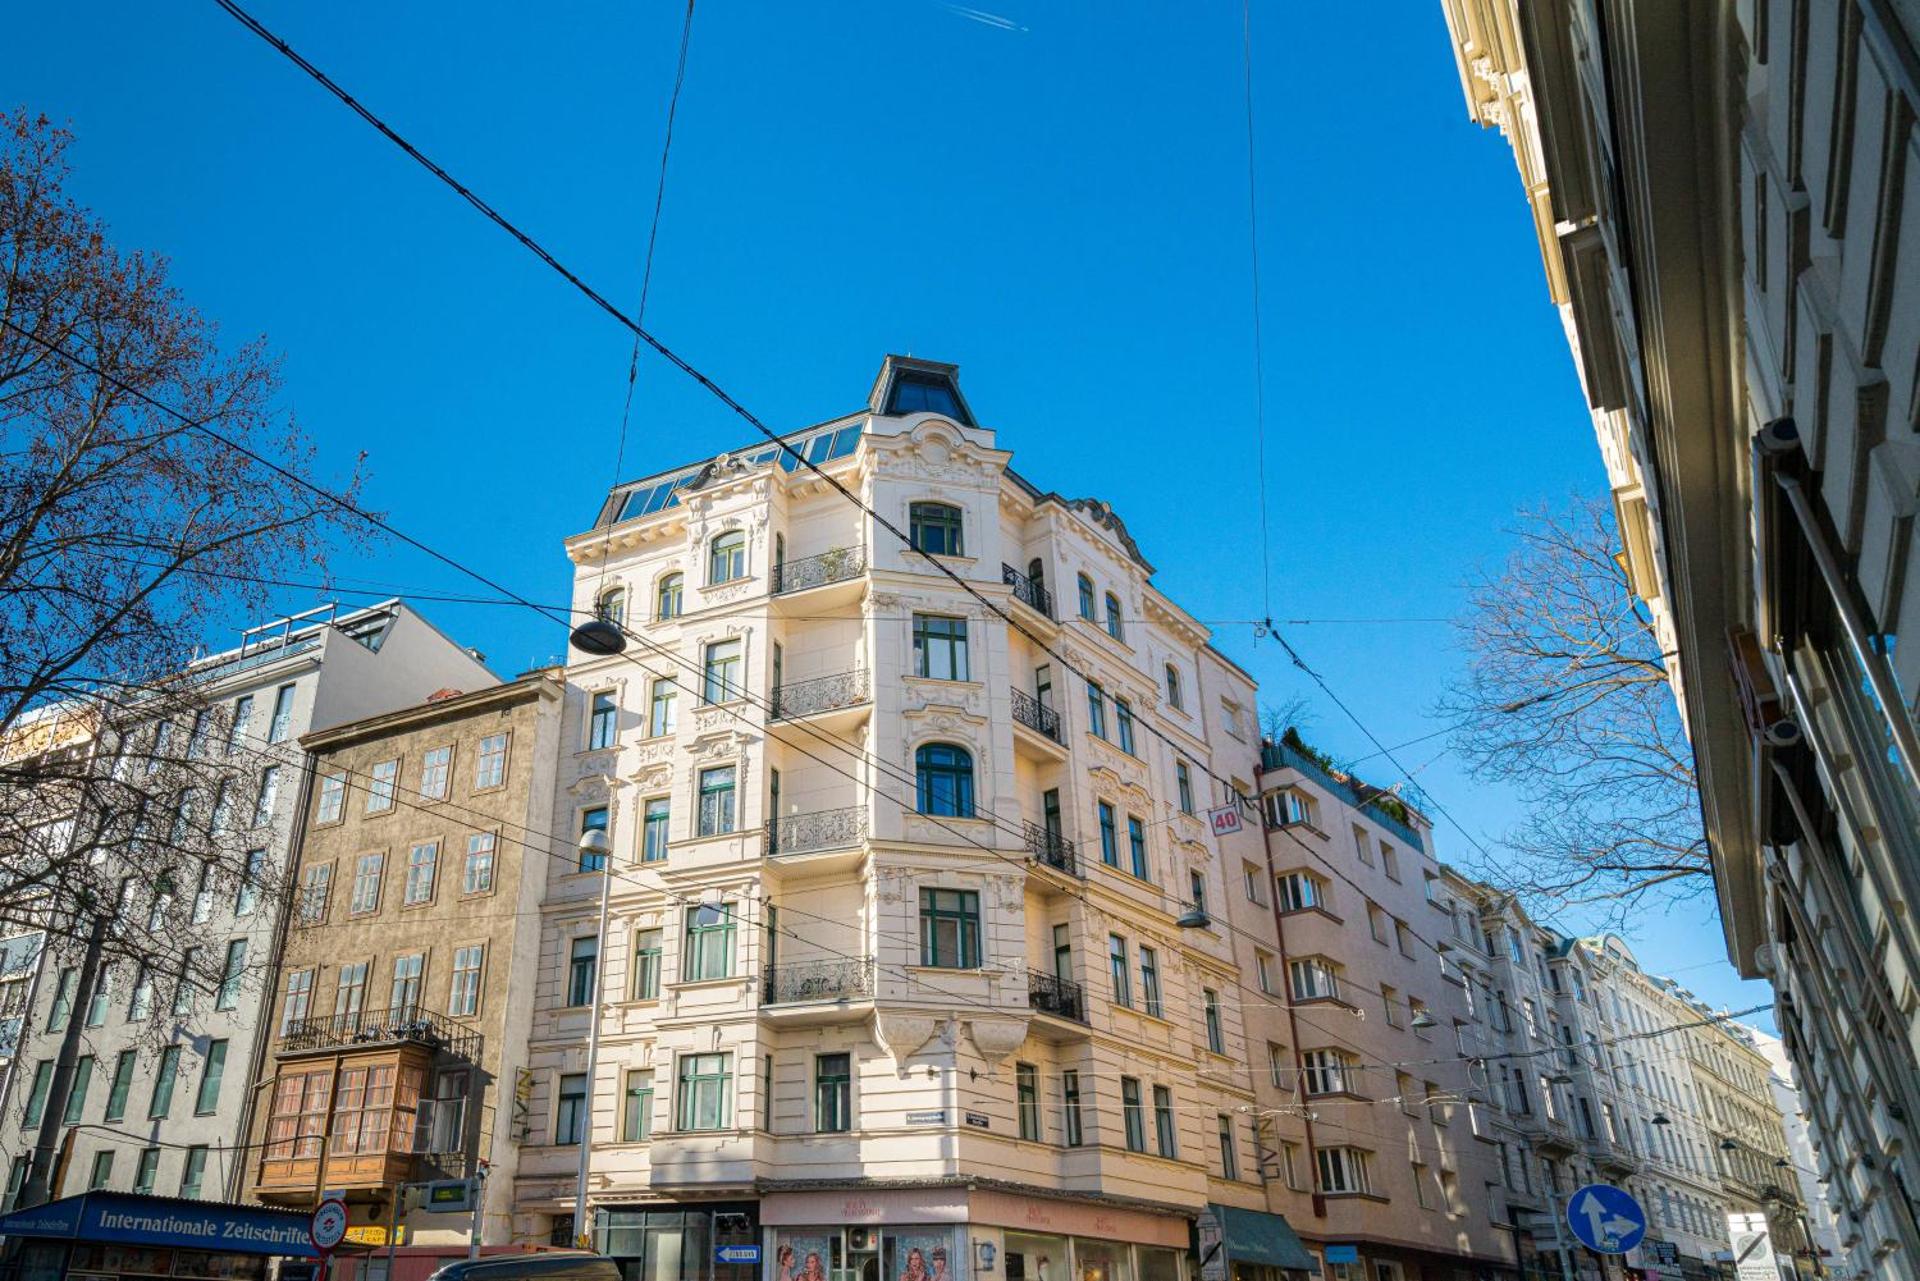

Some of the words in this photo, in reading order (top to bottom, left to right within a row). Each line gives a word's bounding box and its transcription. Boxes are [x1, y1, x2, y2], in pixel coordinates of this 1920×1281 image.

[1215, 811, 1237, 830] 40
[99, 1210, 217, 1237] Internationale
[222, 1221, 313, 1246] Zeitschrifte
